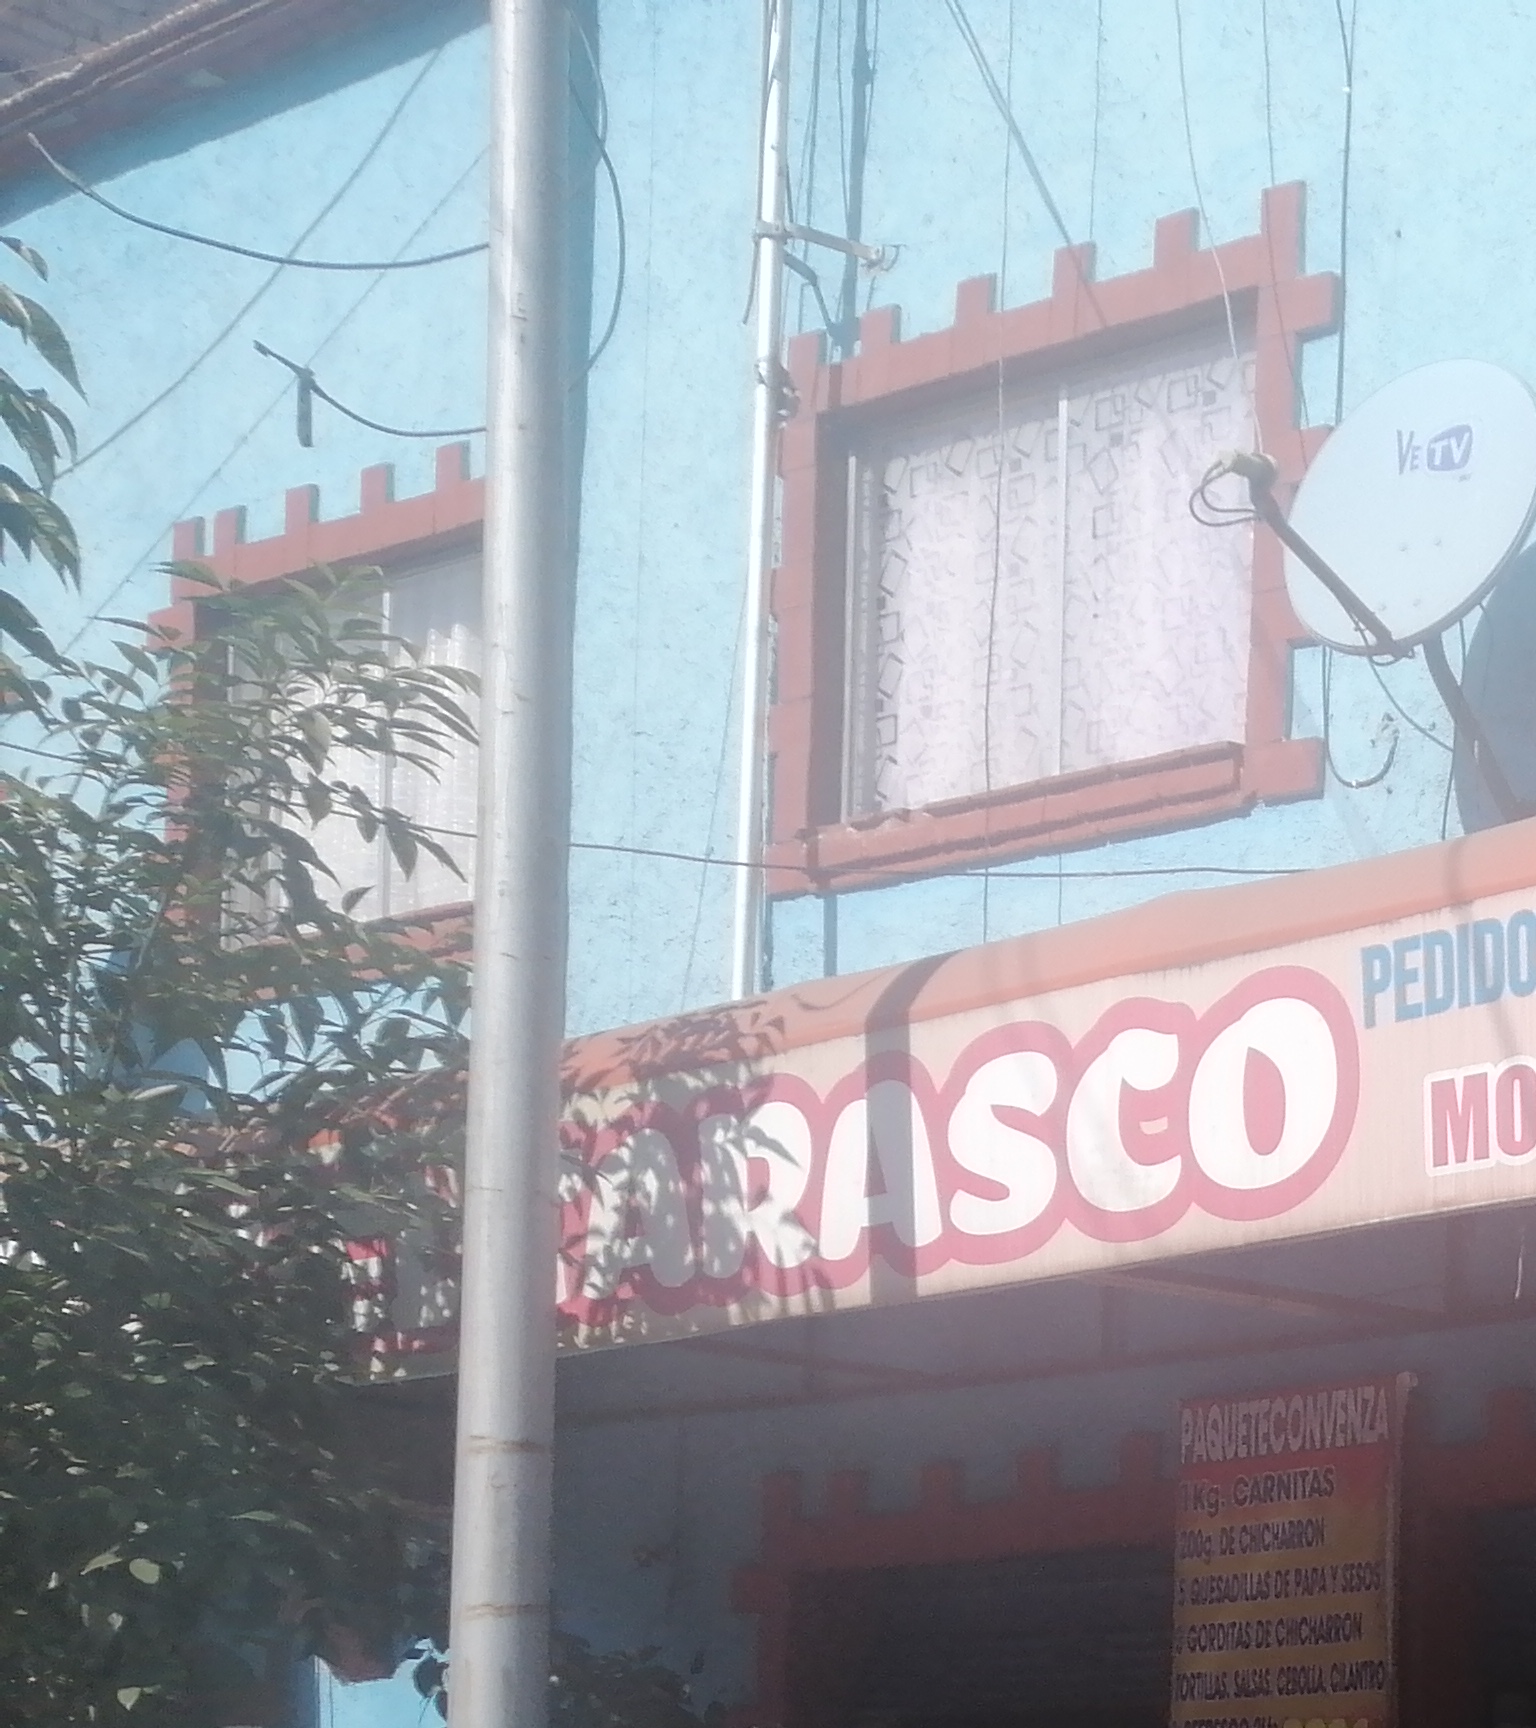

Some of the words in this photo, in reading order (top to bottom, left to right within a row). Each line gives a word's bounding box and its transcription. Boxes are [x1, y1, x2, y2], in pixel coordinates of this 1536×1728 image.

[556, 968, 1358, 1325] ARASCO
[1232, 1464, 1336, 1508] CARNITAS
[1219, 1525, 1236, 1556] DE
[1238, 1516, 1326, 1555] CHICHARRON
[1190, 1569, 1271, 1606] QUESADILLAS
[1274, 1568, 1292, 1599] DE
[1293, 1566, 1328, 1598] PAPA
[1329, 1564, 1340, 1595] Y
[1186, 1619, 1252, 1653] GORDITAS
[1254, 1618, 1273, 1650] DE
[1274, 1612, 1364, 1648] CHICHARRON
